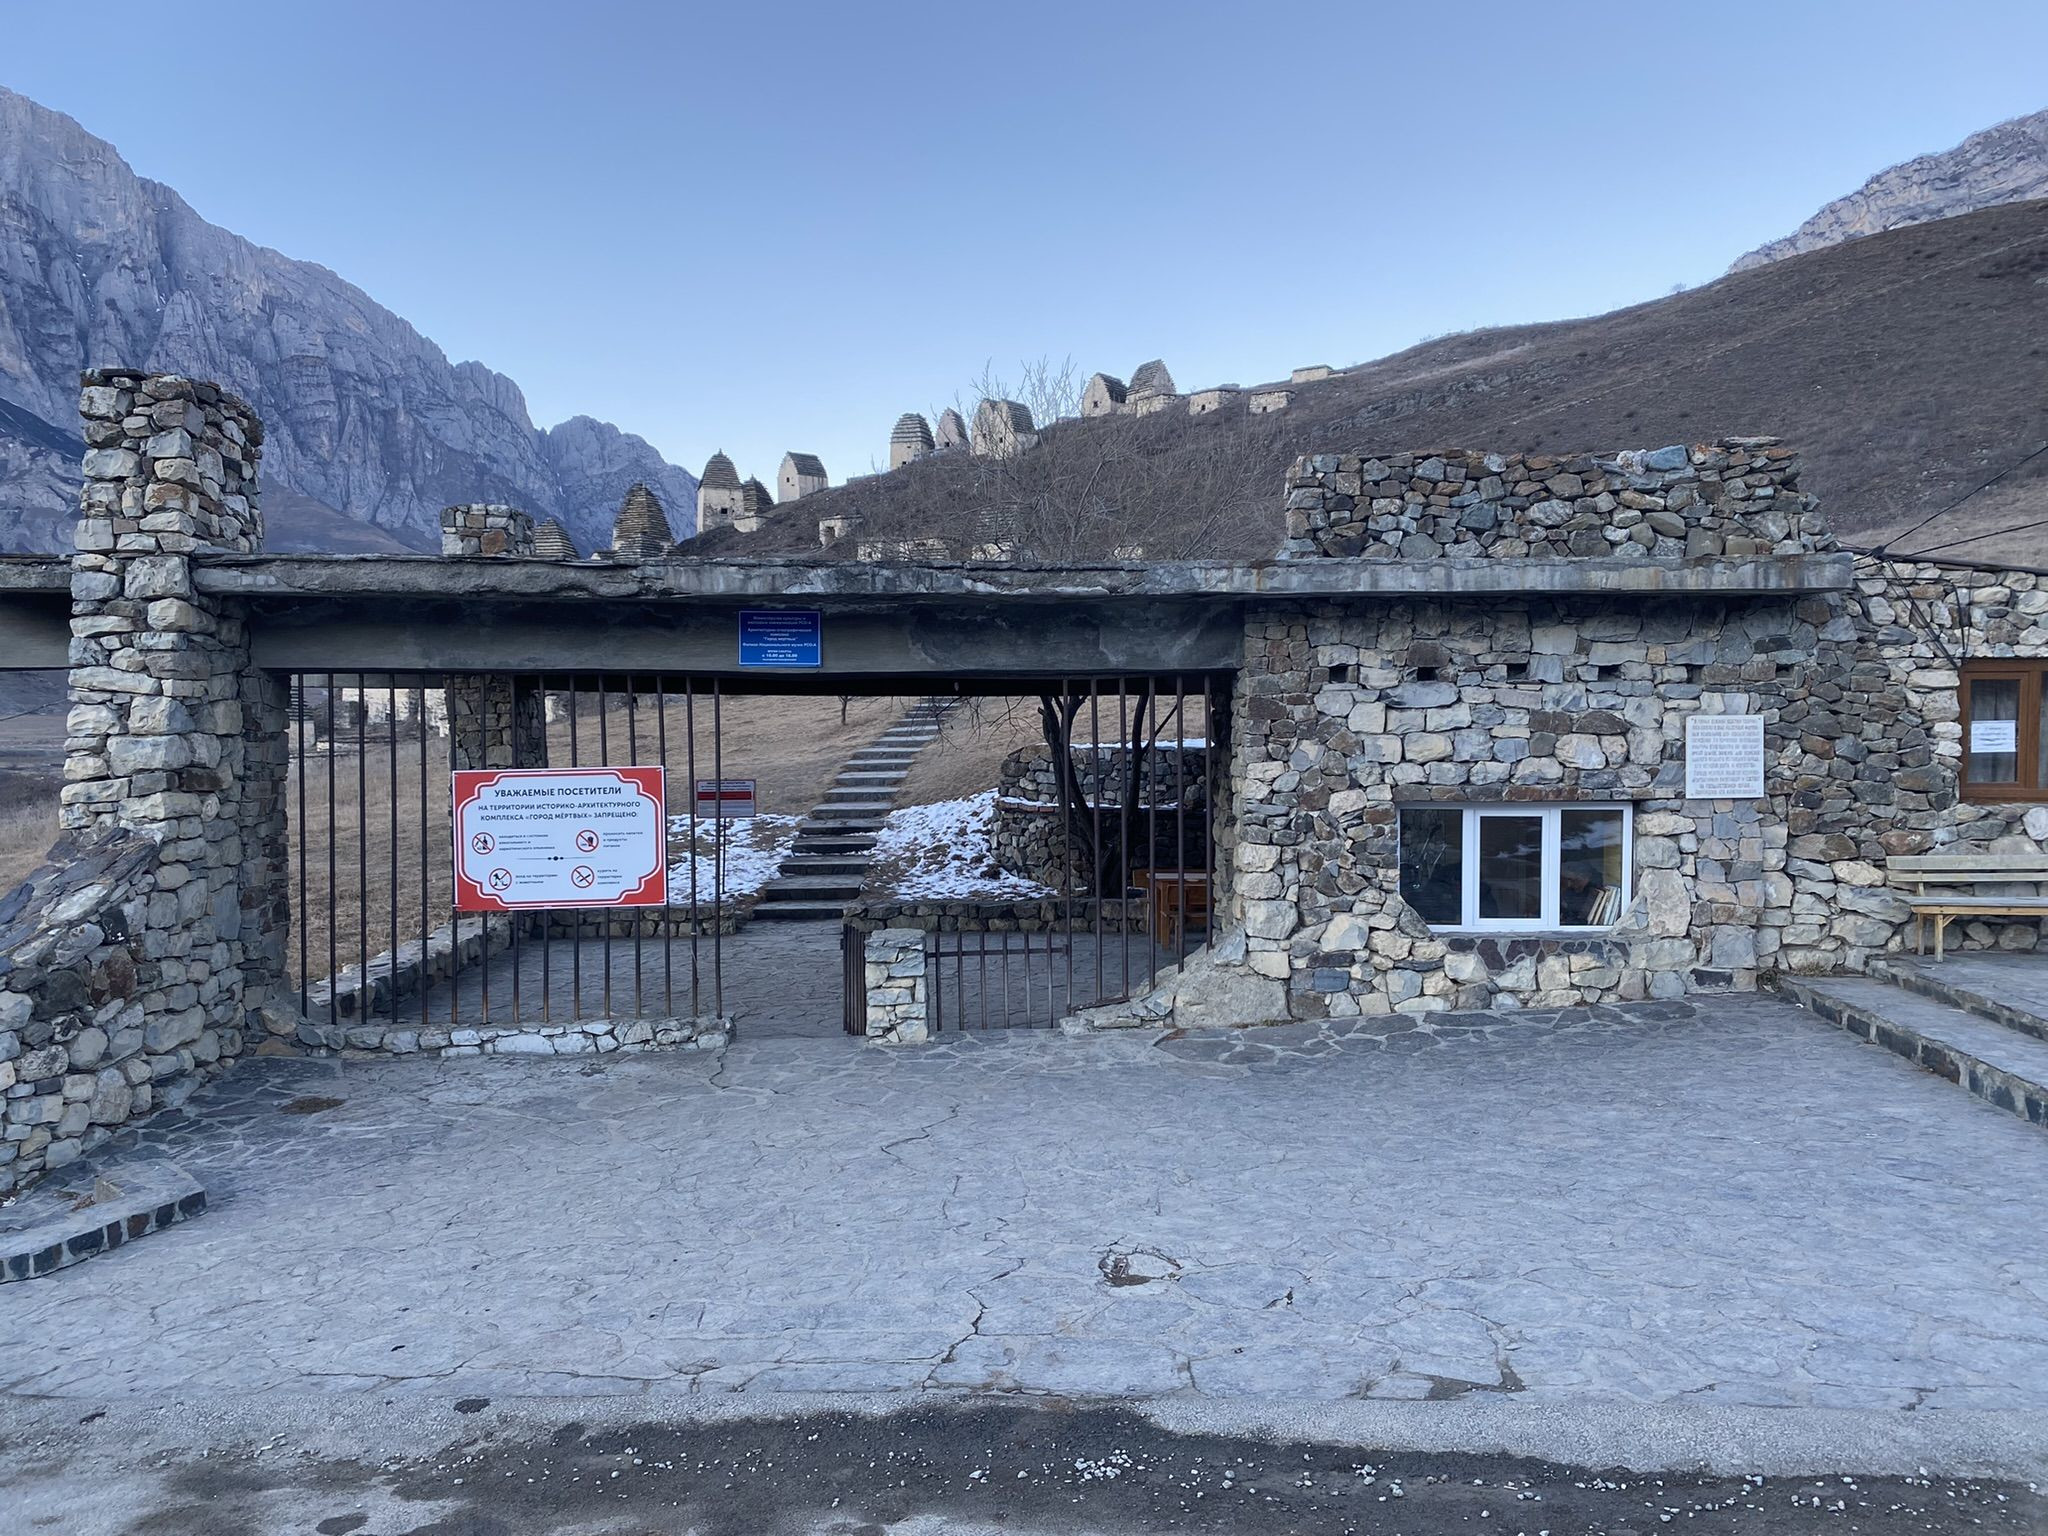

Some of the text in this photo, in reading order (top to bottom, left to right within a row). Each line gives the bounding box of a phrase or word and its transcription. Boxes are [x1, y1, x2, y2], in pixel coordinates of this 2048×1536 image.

[494, 787, 622, 798] УВАЖАЕМЫЕ ПОСЕТИТЕЛИ
[489, 803, 535, 811] ТЕРРИТОРИИ
[536, 801, 641, 810] ИСТОРИКО-АРХИТЕКТУРНОГО
[525, 813, 553, 821] «ГОРОД
